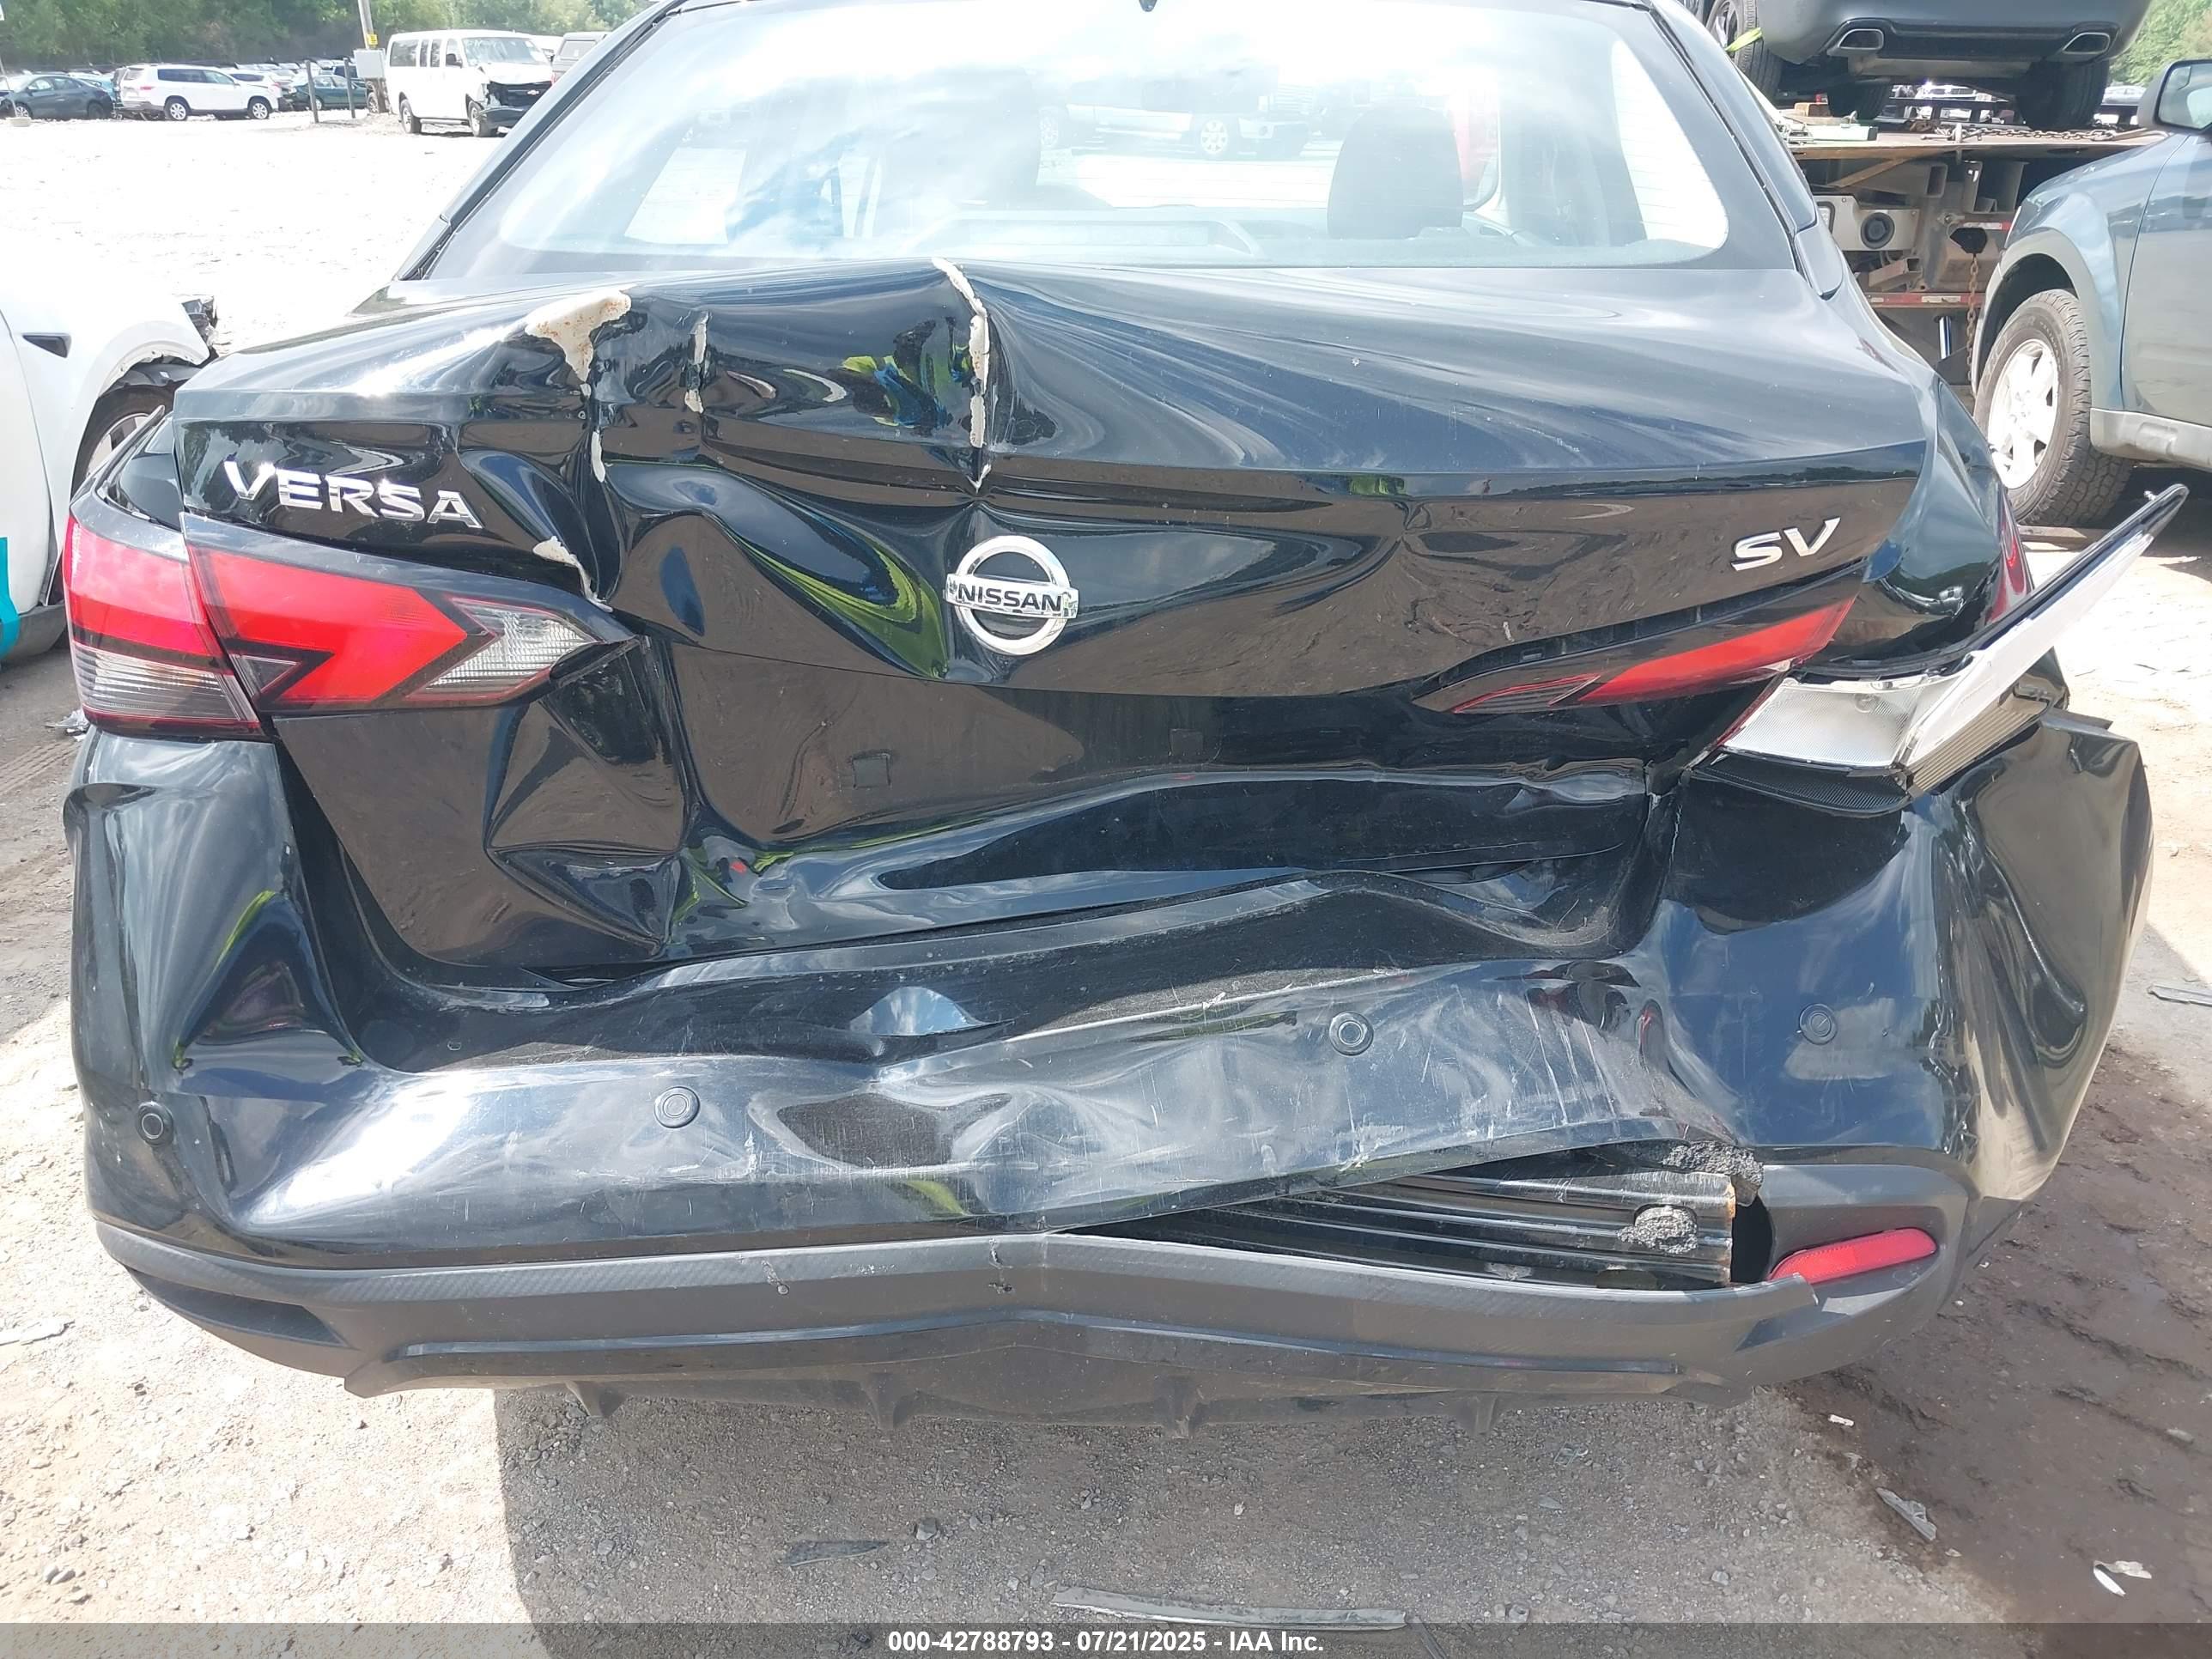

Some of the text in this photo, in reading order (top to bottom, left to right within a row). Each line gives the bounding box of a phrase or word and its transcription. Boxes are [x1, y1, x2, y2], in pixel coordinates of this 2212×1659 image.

[223, 460, 483, 529] VERSA
[1730, 517, 1841, 572] SV
[957, 583, 1062, 612] NISSAN
